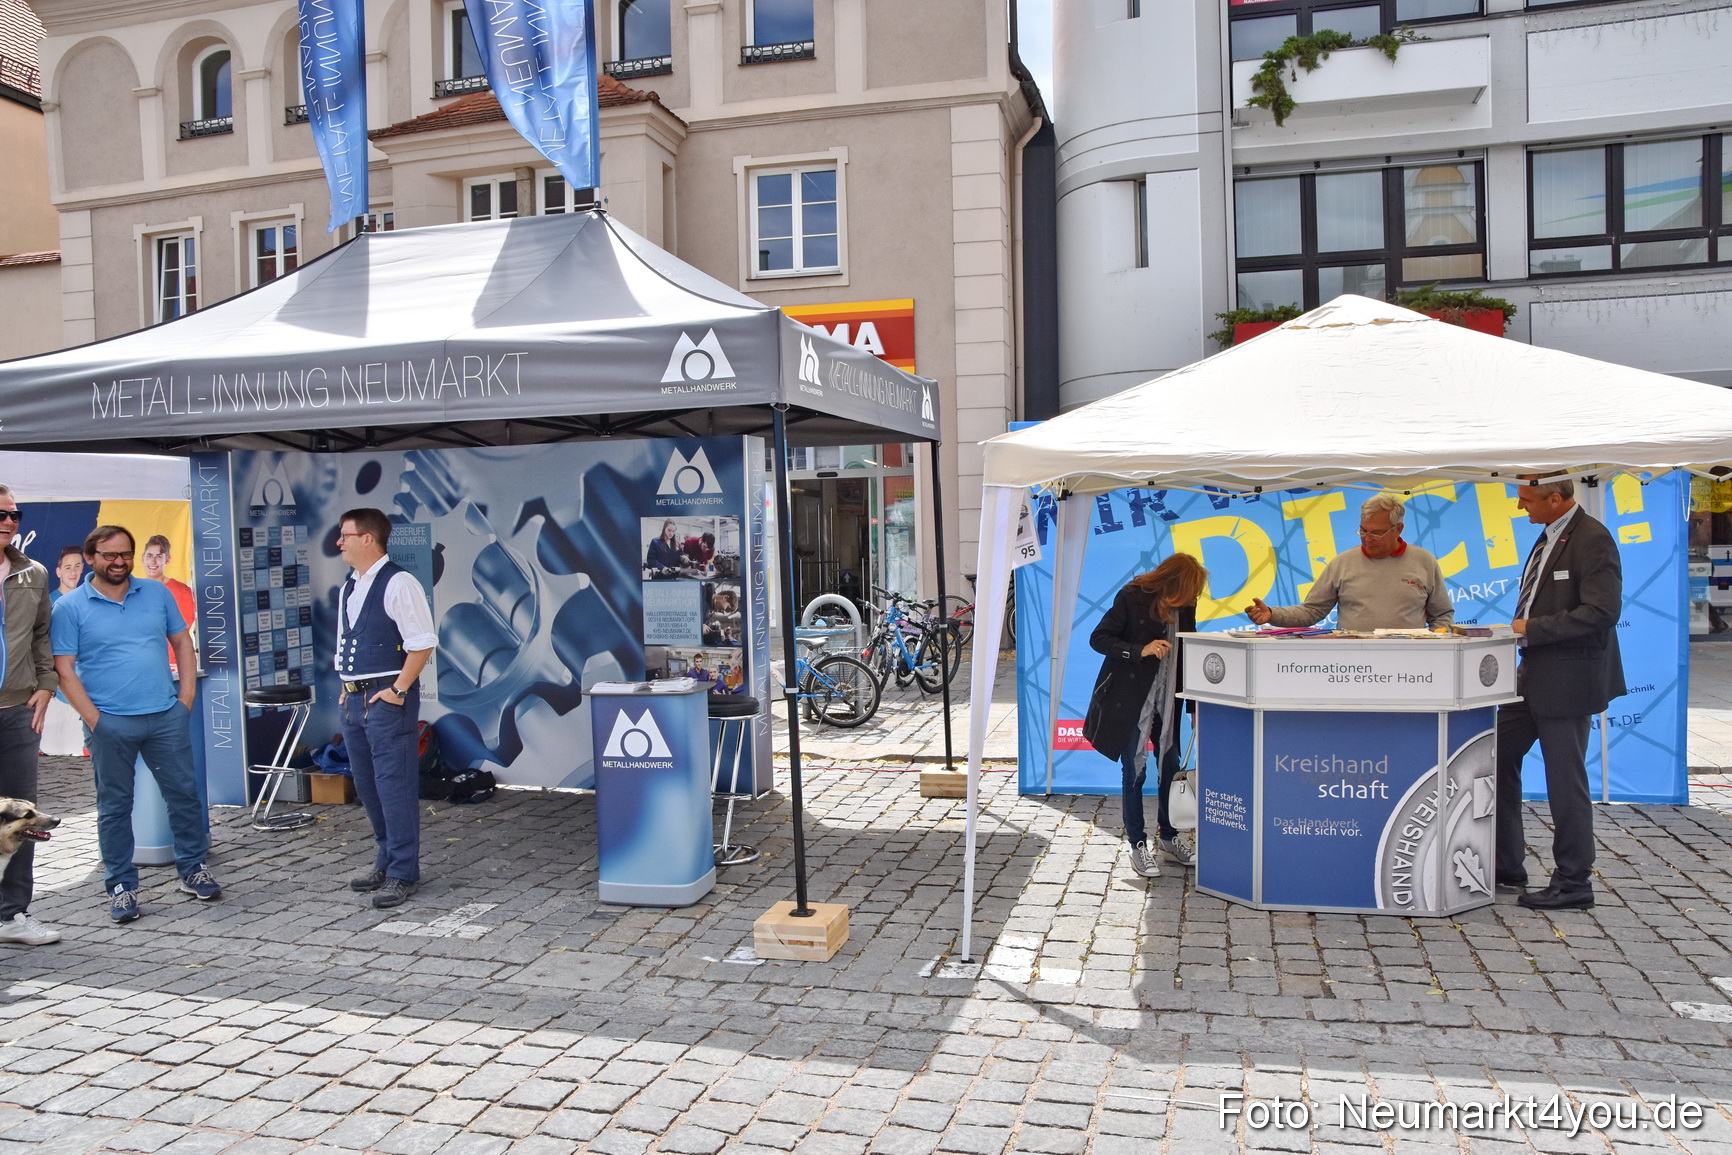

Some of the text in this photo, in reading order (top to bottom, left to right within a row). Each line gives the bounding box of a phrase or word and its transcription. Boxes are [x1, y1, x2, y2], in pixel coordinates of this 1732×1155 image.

[92, 352, 529, 419] METALL-INNUNG NEUMARKT
[661, 382, 737, 395] METALLHANDWERK
[655, 497, 724, 506] METALLHANDWERK
[391, 526, 426, 536] GSBERUFE
[1021, 545, 1036, 559] 95
[199, 462, 233, 749] METALL-INNUNG NEUMARKT
[753, 570, 769, 737] METALL-INNUNG
[1277, 662, 1373, 674] Informationen
[1328, 672, 1433, 684] aus erster Hand
[602, 761, 673, 769] METALLHANDWERK
[1275, 754, 1389, 774] Kreishand
[1205, 788, 1243, 805] Der starke
[1318, 779, 1389, 799] schaft
[1205, 797, 1247, 814] Partner des
[1205, 806, 1244, 822] regionalen
[1205, 813, 1249, 832] Handwerks.
[1273, 817, 1359, 829] Das Handwerk
[1282, 824, 1363, 837] stellt sich vor.
[1391, 777, 1460, 910] KREISHAND
